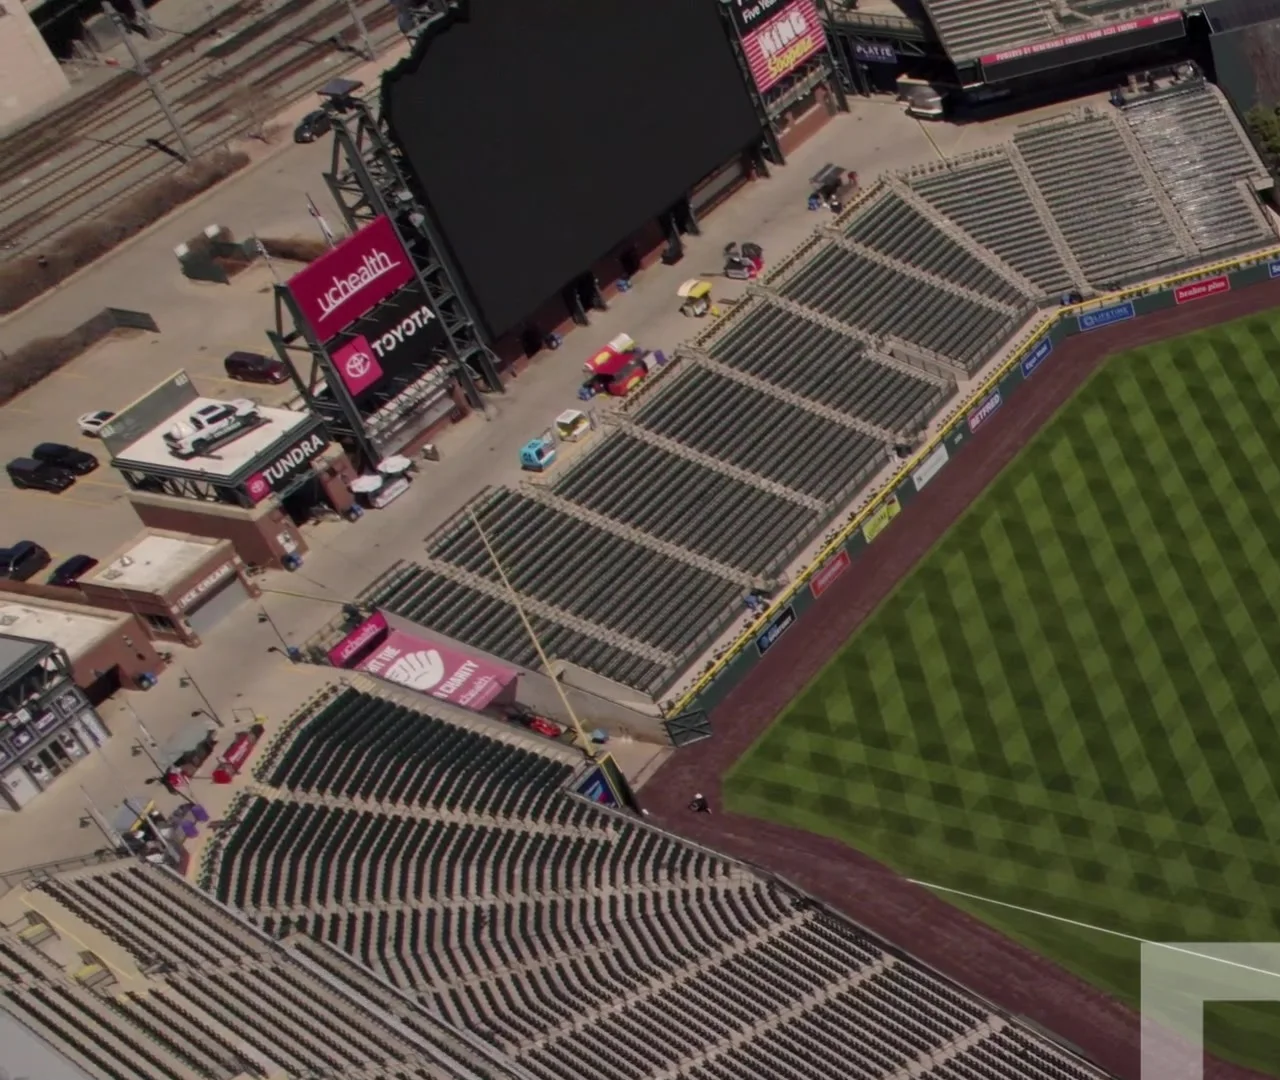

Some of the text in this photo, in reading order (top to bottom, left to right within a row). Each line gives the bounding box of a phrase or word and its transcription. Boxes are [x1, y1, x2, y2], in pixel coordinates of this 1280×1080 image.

[757, 11, 807, 59] KING
[317, 248, 400, 322] uchealth
[1178, 279, 1226, 300] brakes plus
[371, 305, 435, 358] TOYOTA
[970, 393, 1000, 429] BETFRED
[262, 433, 325, 486] TUNDRA
[445, 660, 480, 695] CHARITY
